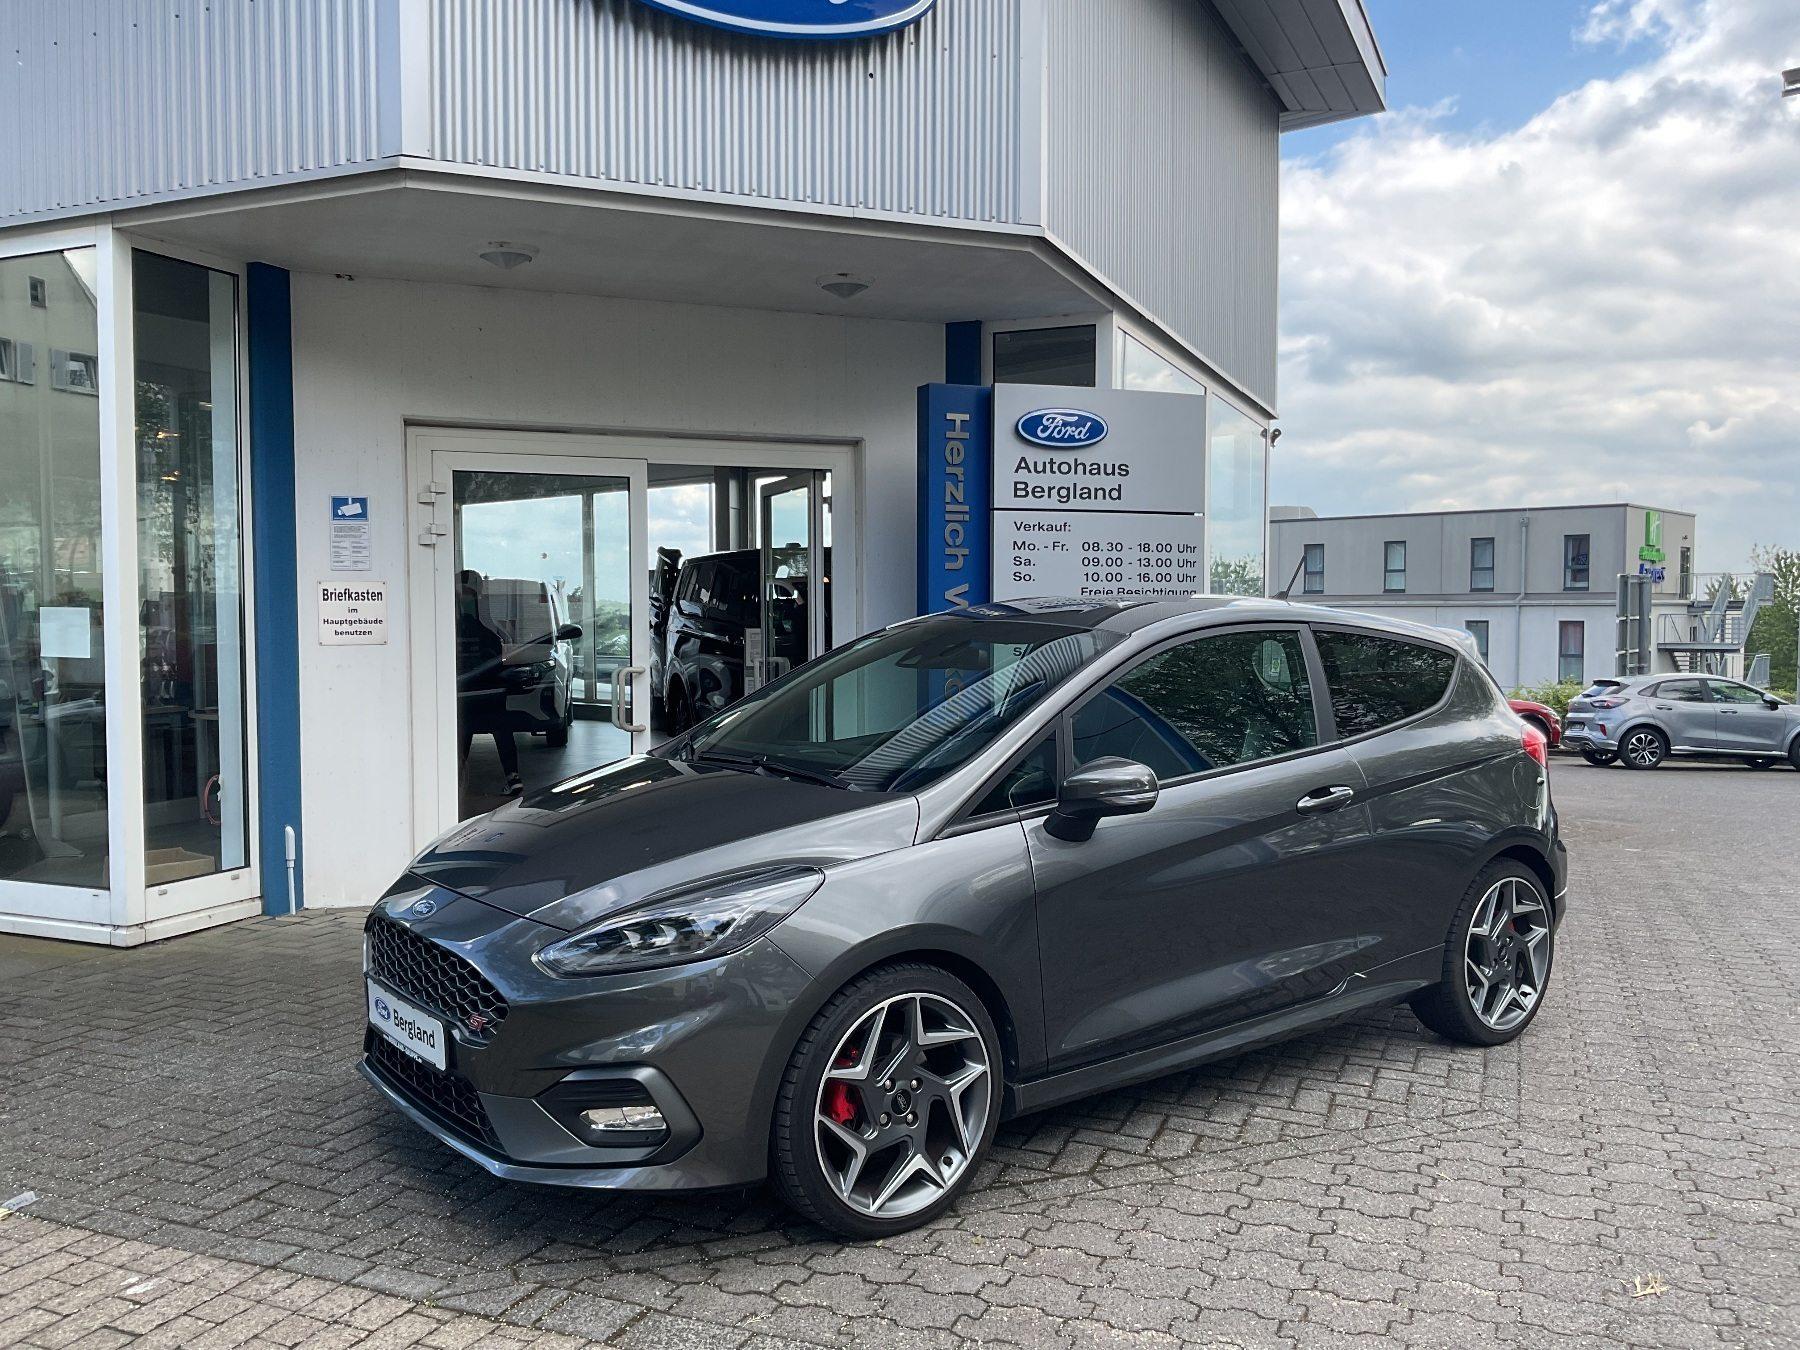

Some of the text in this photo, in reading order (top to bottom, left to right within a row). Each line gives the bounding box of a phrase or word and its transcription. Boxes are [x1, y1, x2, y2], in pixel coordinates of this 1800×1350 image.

[1037, 413, 1091, 440] Ford
[1013, 457, 1130, 477] Autohaus
[944, 412, 970, 571] Herzlich
[1013, 481, 1122, 504] Bergland
[1013, 521, 1071, 533] Verkauf:
[1012, 541, 1040, 552] Mo.
[1052, 541, 1069, 552] Fr.
[1081, 541, 1123, 552] 08.30
[1137, 542, 1173, 553] 18.00
[1177, 543, 1197, 554] Uhr
[1012, 556, 1036, 567] Sa.
[1081, 556, 1123, 567] 09.00
[1137, 557, 1172, 568] 13.00
[1177, 558, 1197, 569] Uhr
[1012, 571, 1036, 582] So.
[1083, 571, 1123, 583] 10.00
[1137, 572, 1172, 583] 16.00
[1177, 573, 1197, 583] Uhr
[322, 588, 383, 602] Briefkasten
[1081, 587, 1197, 596] Freie Besichtigung
[348, 606, 358, 614] im
[323, 618, 384, 626] Hauptgebäude
[393, 1009, 436, 1049] Bergland
